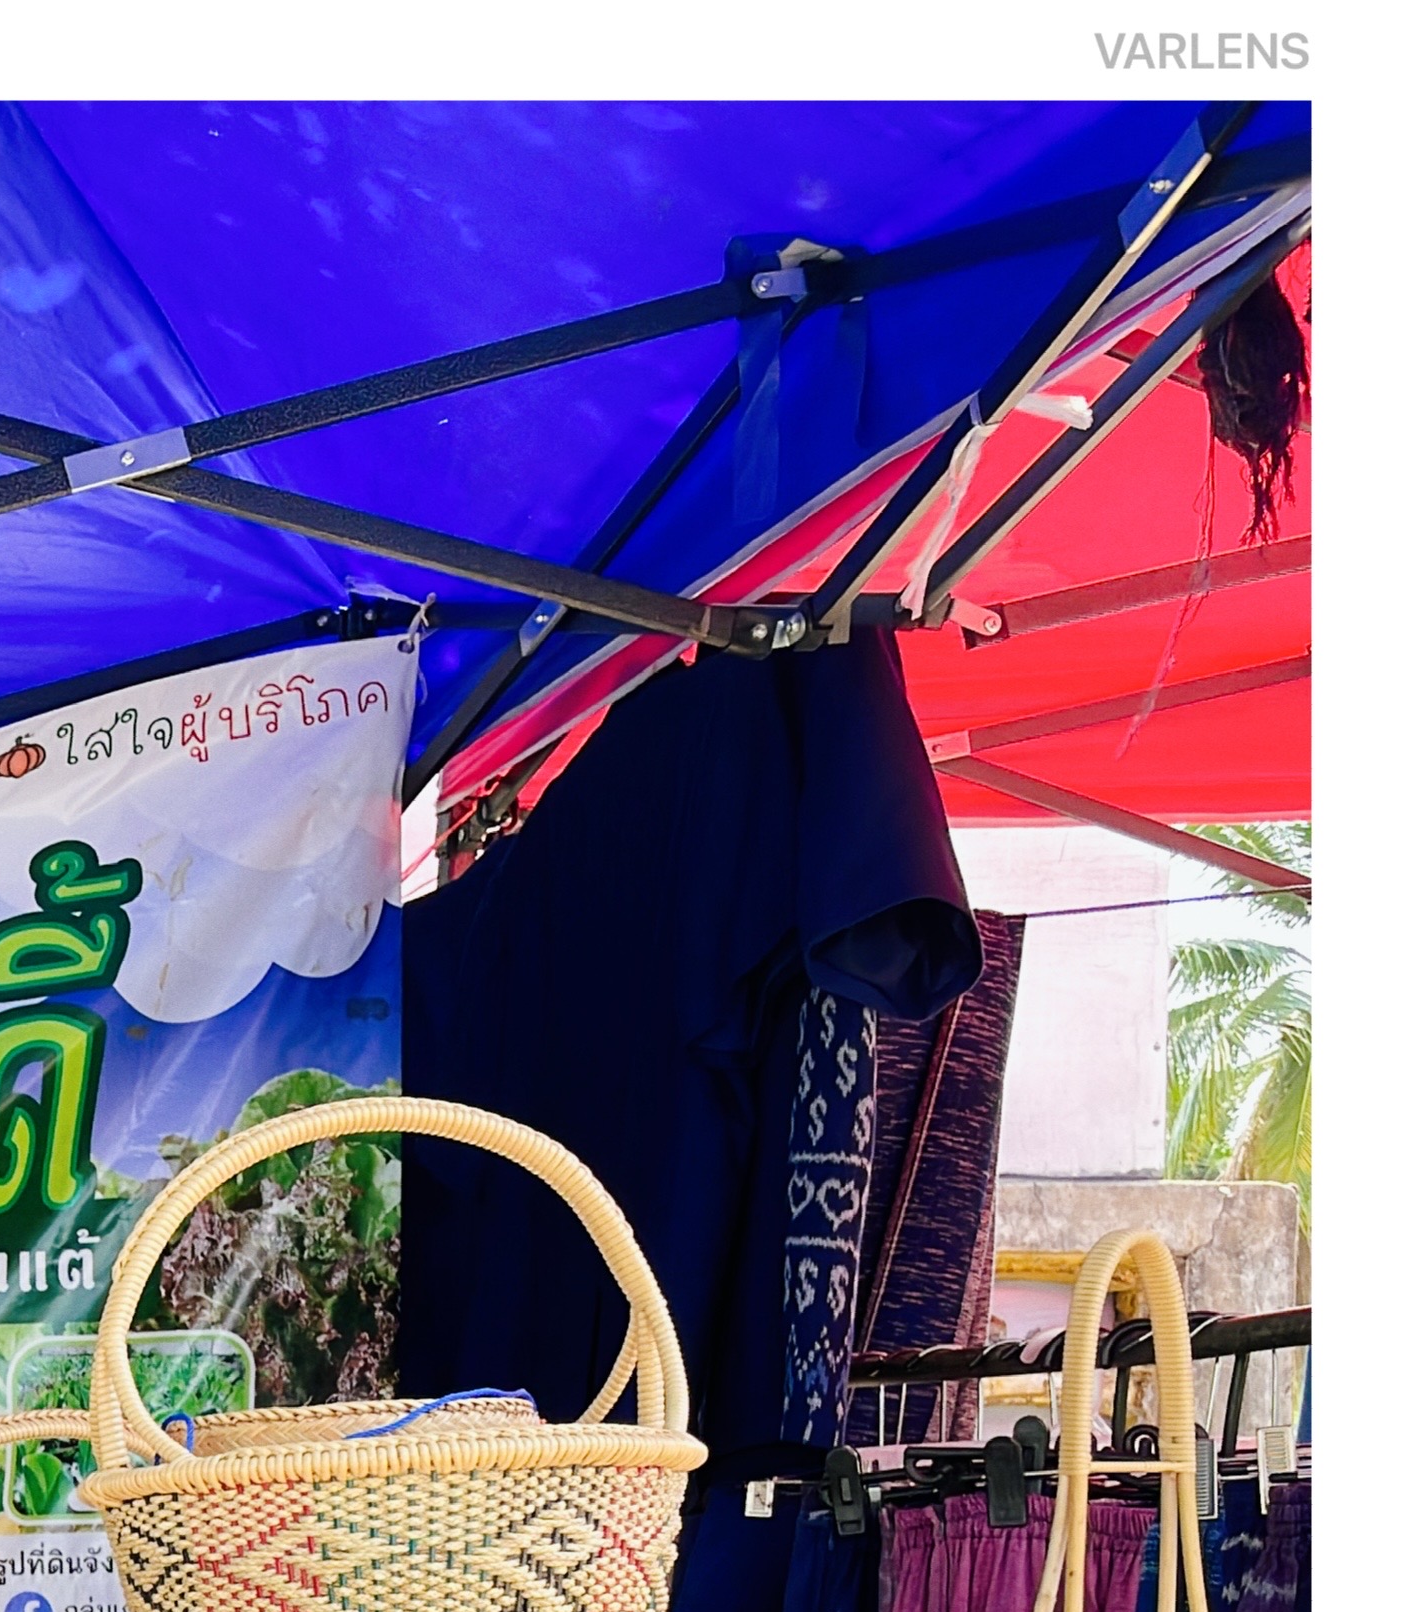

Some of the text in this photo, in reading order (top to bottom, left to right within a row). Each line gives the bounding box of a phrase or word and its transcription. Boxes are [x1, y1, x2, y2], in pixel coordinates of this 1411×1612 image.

[55, 673, 390, 764] ใส่ใจผู้บริโภค
